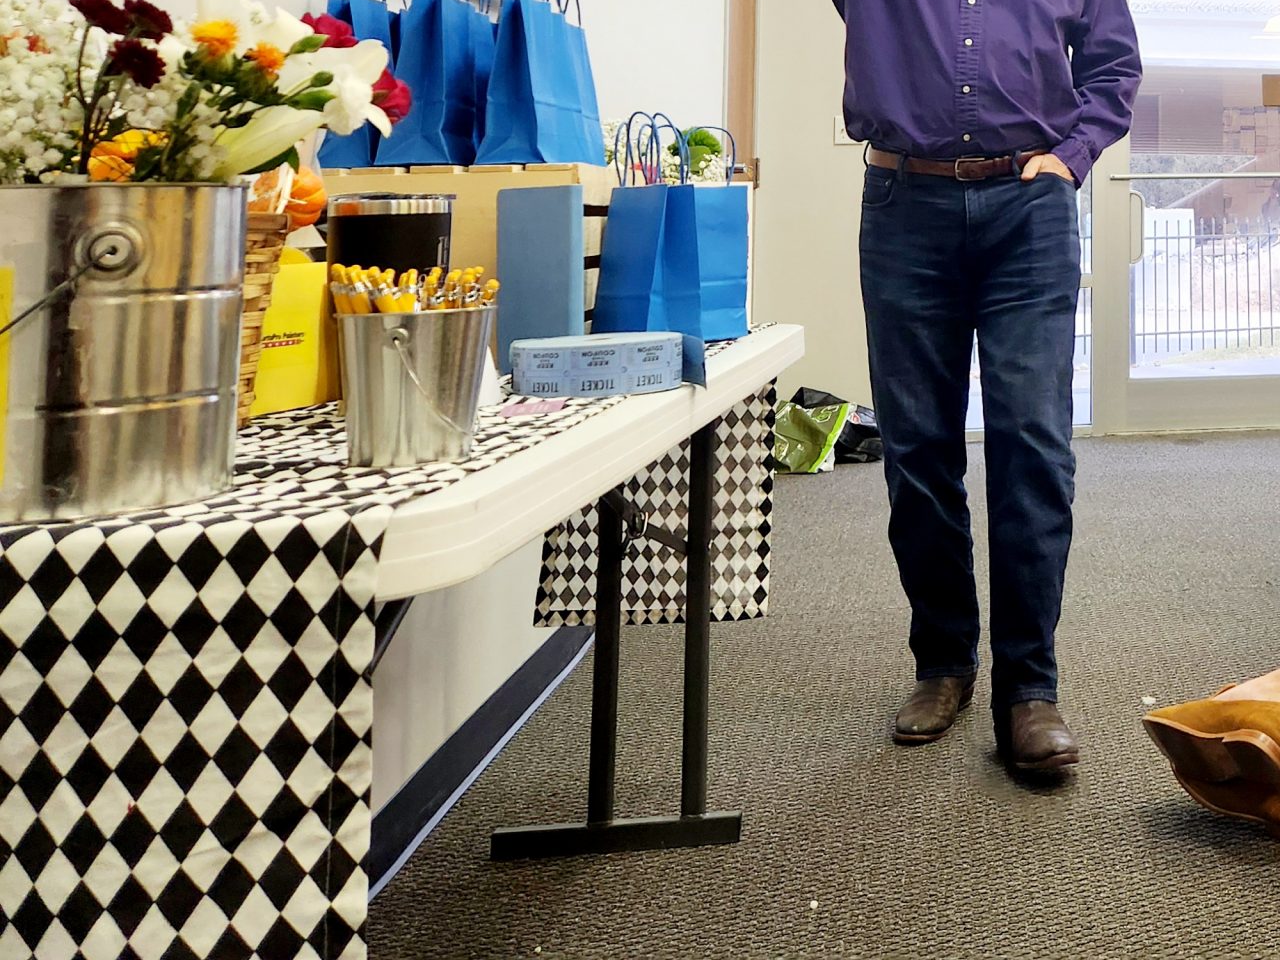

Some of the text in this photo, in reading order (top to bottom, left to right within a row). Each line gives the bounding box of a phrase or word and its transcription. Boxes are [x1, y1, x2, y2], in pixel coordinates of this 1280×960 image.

[581, 349, 616, 358] COUPON
[580, 379, 615, 391] TICKET
[637, 373, 663, 387] TICKET
[532, 381, 560, 393] TICKET
